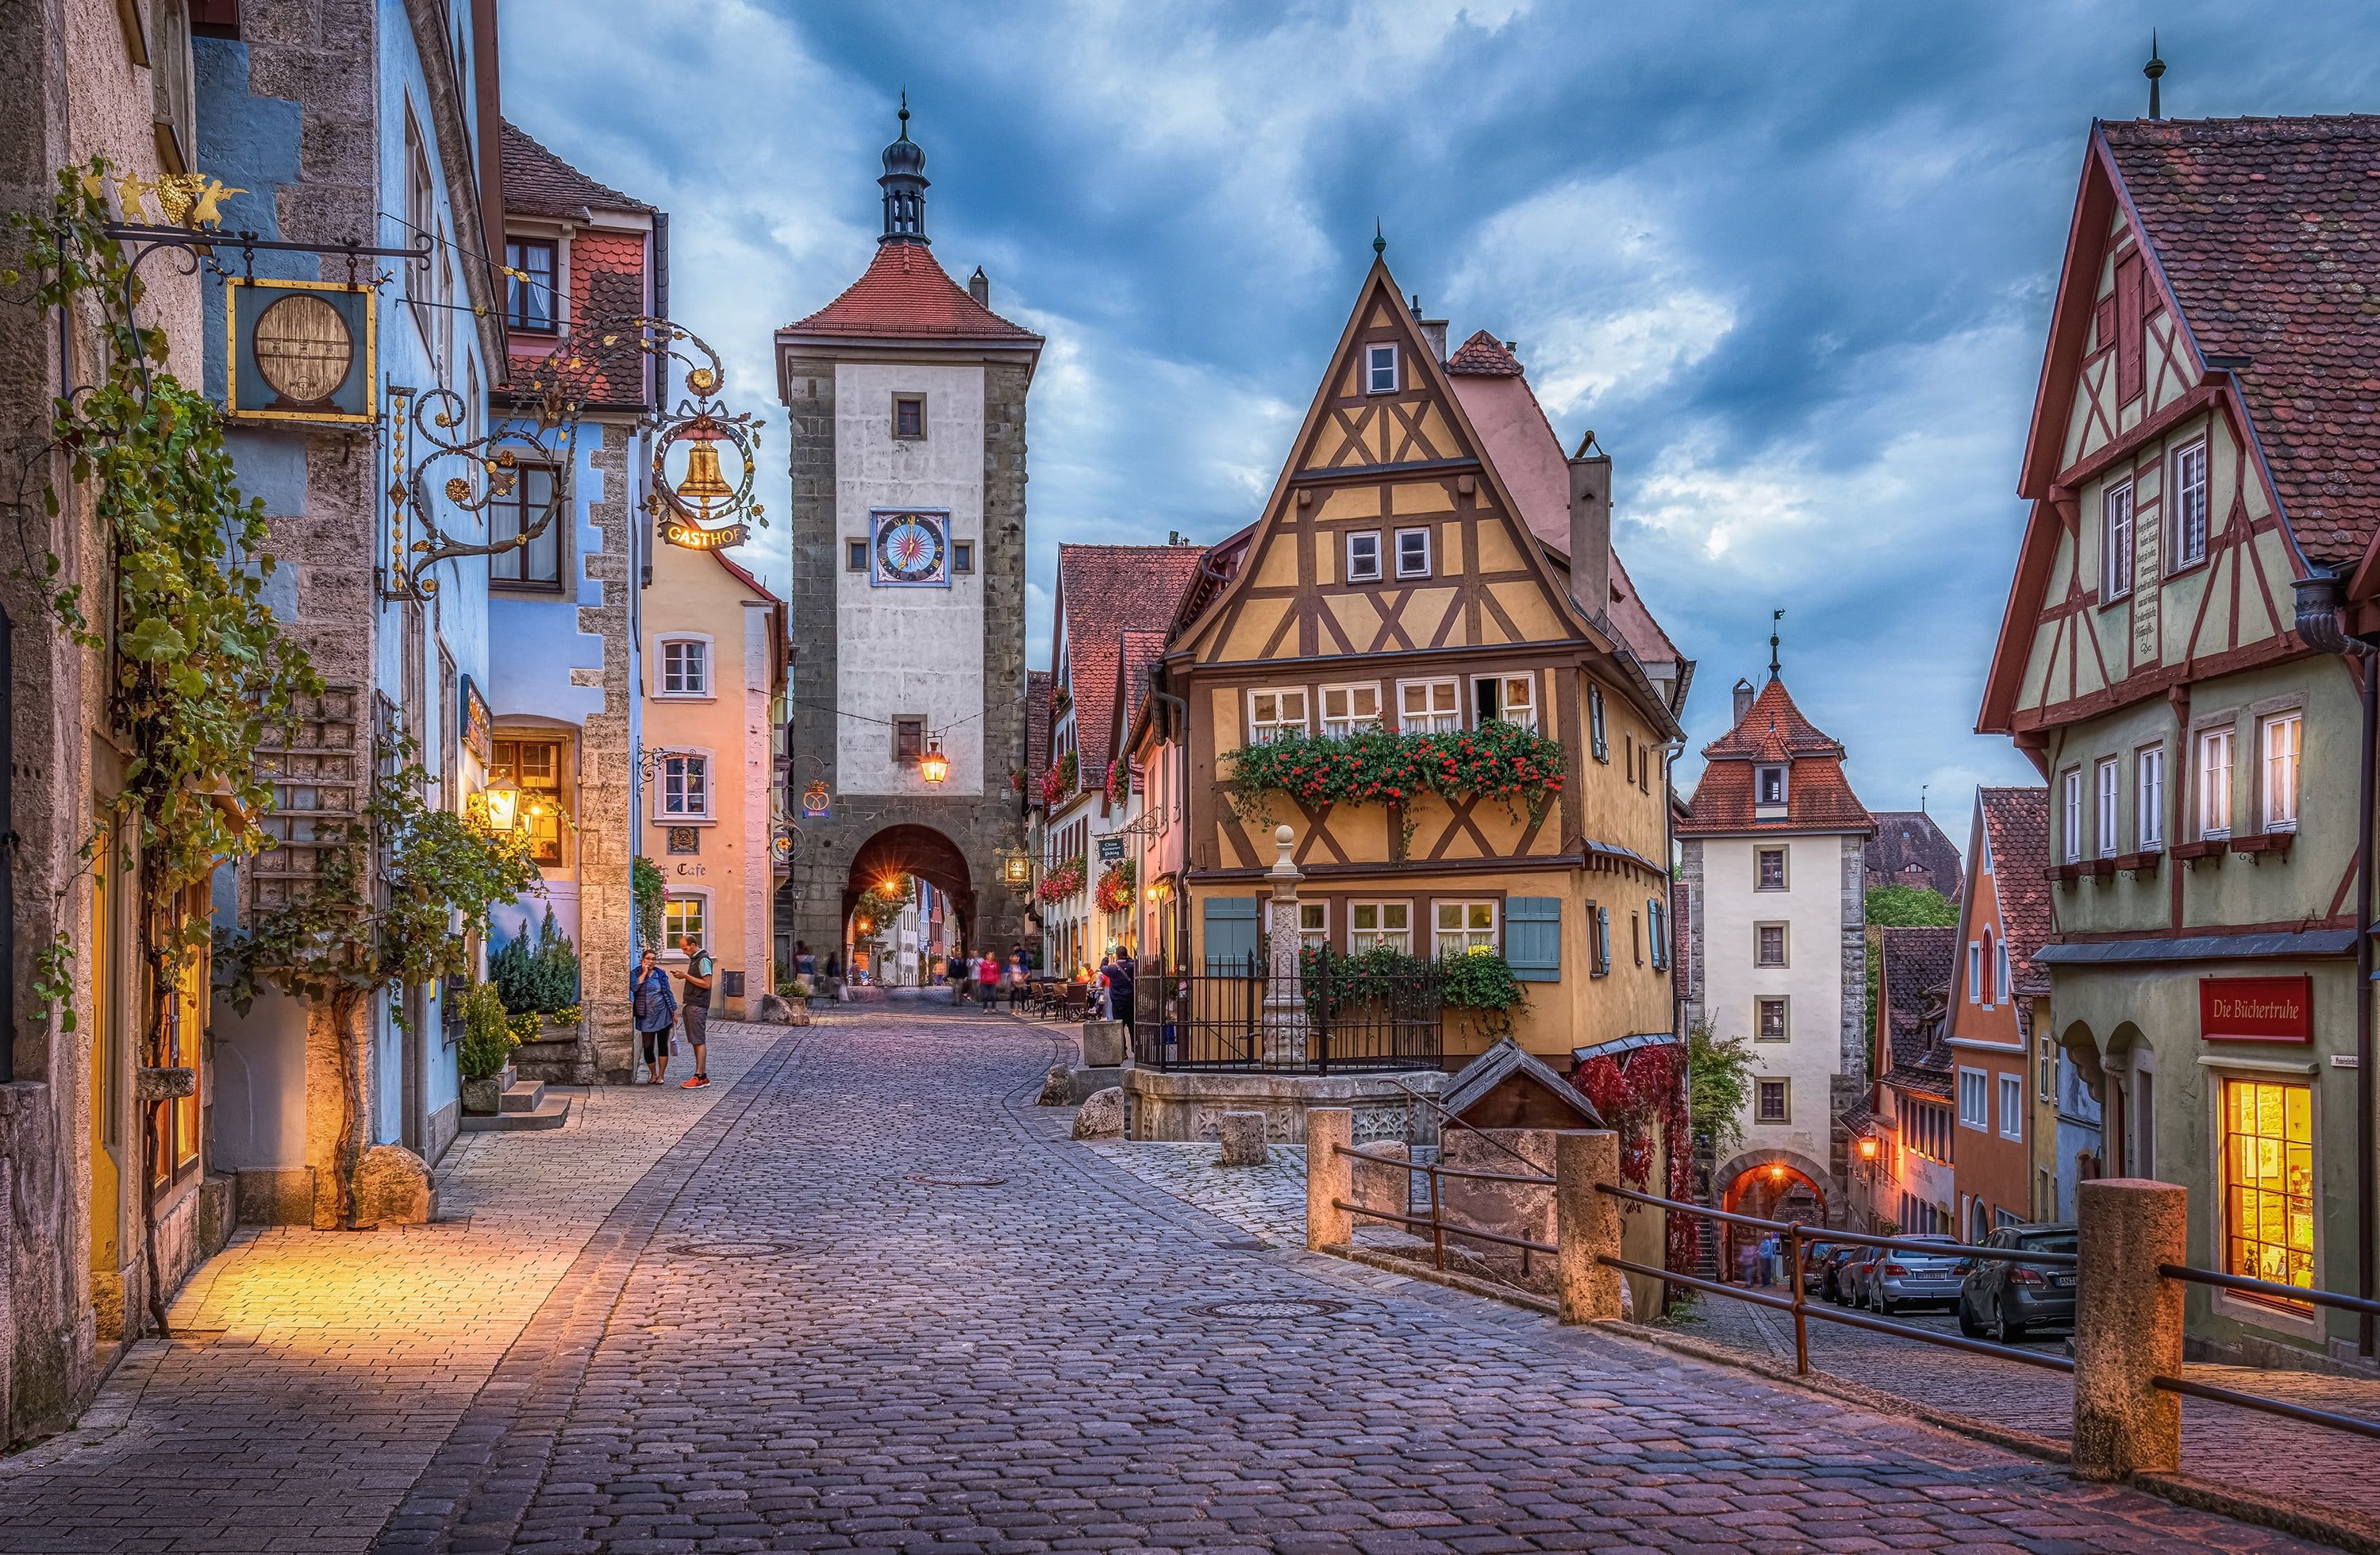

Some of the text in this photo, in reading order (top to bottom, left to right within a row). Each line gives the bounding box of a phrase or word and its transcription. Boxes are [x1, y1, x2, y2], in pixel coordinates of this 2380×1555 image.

[668, 526, 740, 546] GASTHOF
[2213, 999, 2299, 1019] Die Büchertruhe
